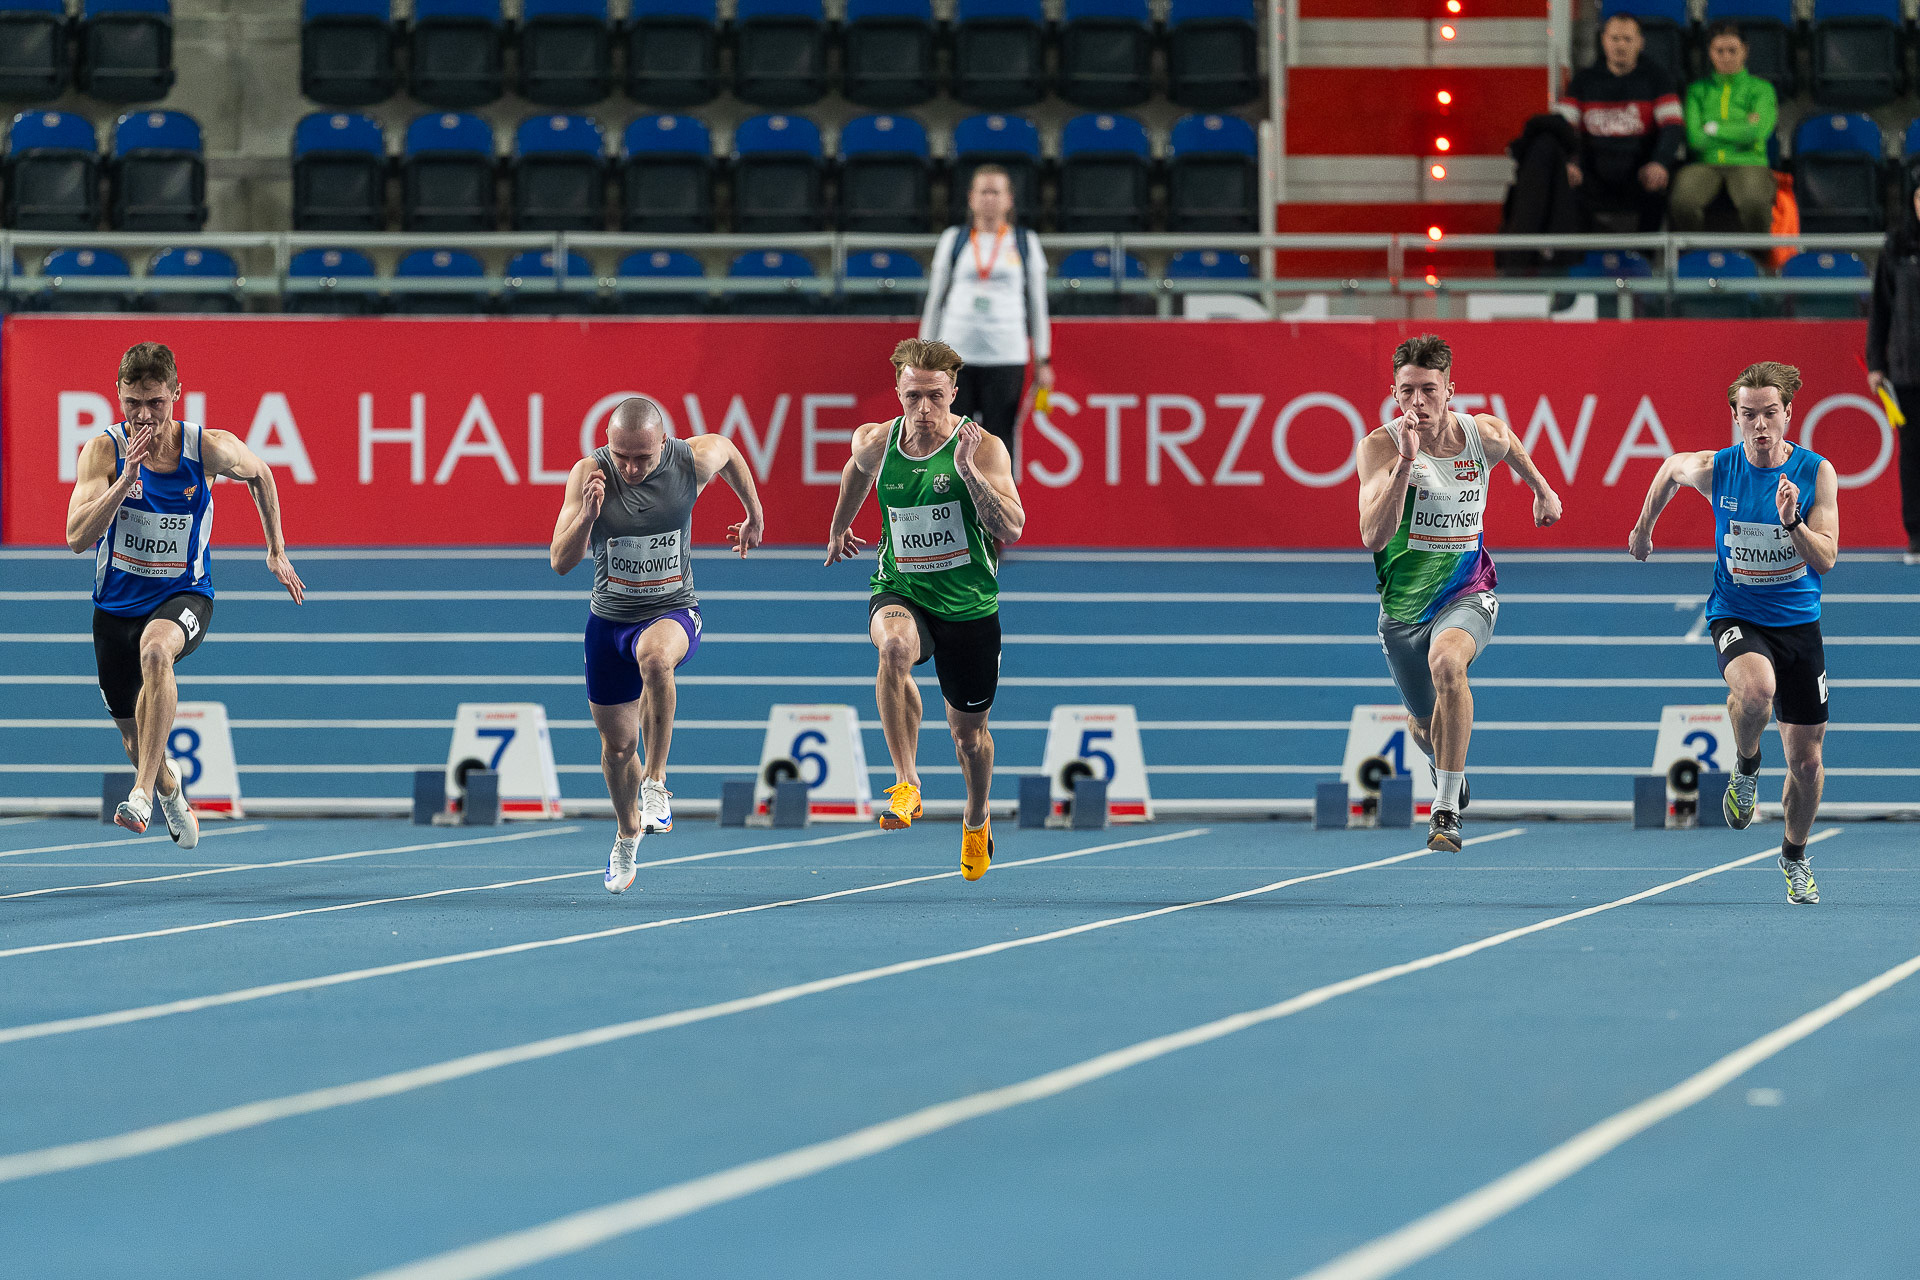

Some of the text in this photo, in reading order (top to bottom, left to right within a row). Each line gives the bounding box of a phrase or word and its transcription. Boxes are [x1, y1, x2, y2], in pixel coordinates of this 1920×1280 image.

[57, 390, 317, 485] PA
[358, 391, 858, 486] HALOWE
[1013, 391, 1676, 488] STRZOWA
[1453, 459, 1475, 468] MKS
[1458, 489, 1480, 503] 201
[931, 506, 951, 521] 80
[1415, 510, 1480, 528] BUCZYŃSKI
[159, 516, 187, 531] 355
[124, 533, 178, 554] BURDA
[649, 534, 676, 550] 246
[901, 530, 956, 549] KRUPA
[128, 564, 151, 575] TORUŃ
[611, 554, 679, 574] GORZKOWICZ
[912, 560, 953, 570] TORUŃ 2025
[1750, 574, 1793, 584] TORUŃ 2025
[624, 586, 648, 594] TORUŃ
[1724, 629, 1737, 644] 2
[167, 727, 202, 785] 8
[476, 727, 516, 770] 7
[1079, 730, 1116, 785] 5
[1381, 730, 1411, 776] 4
[1682, 731, 1720, 770] 3
[791, 730, 828, 789] 6
